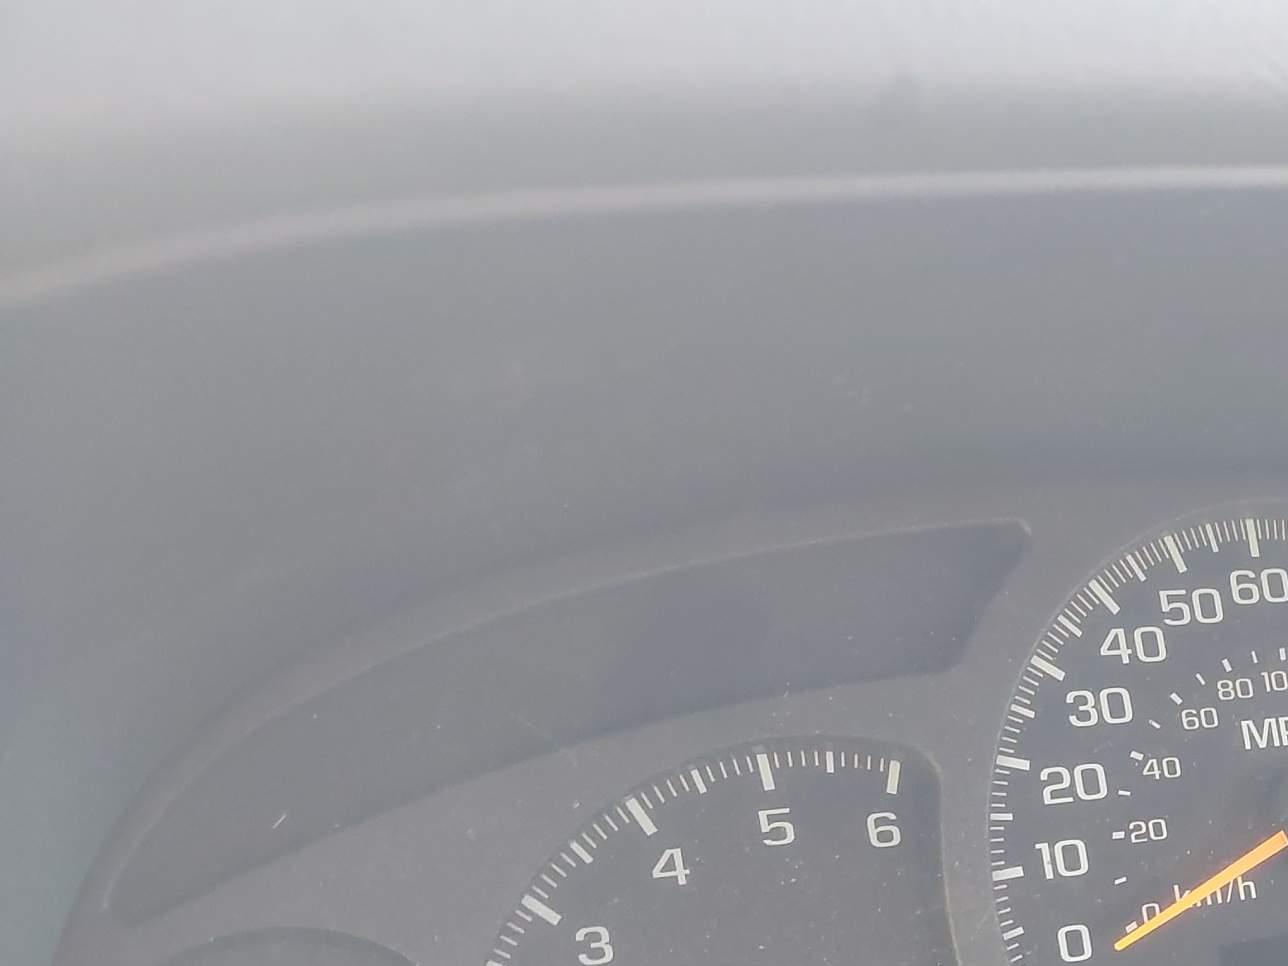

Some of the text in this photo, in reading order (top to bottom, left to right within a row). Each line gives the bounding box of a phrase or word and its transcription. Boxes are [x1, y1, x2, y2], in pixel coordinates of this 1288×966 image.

[1160, 589, 1223, 625] 50
[1101, 627, 1166, 663] 40
[1066, 687, 1132, 727] 30
[1217, 679, 1253, 699] 80
[1182, 707, 1218, 729] 60
[1040, 764, 1106, 804] 20
[1143, 757, 1180, 779] 40
[758, 808, 795, 845] 5
[866, 812, 901, 847] 6
[1130, 818, 1167, 841] 20
[652, 848, 689, 885] 4
[1035, 839, 1088, 879] 10
[576, 927, 614, 964] 3
[1059, 924, 1091, 962] 0
